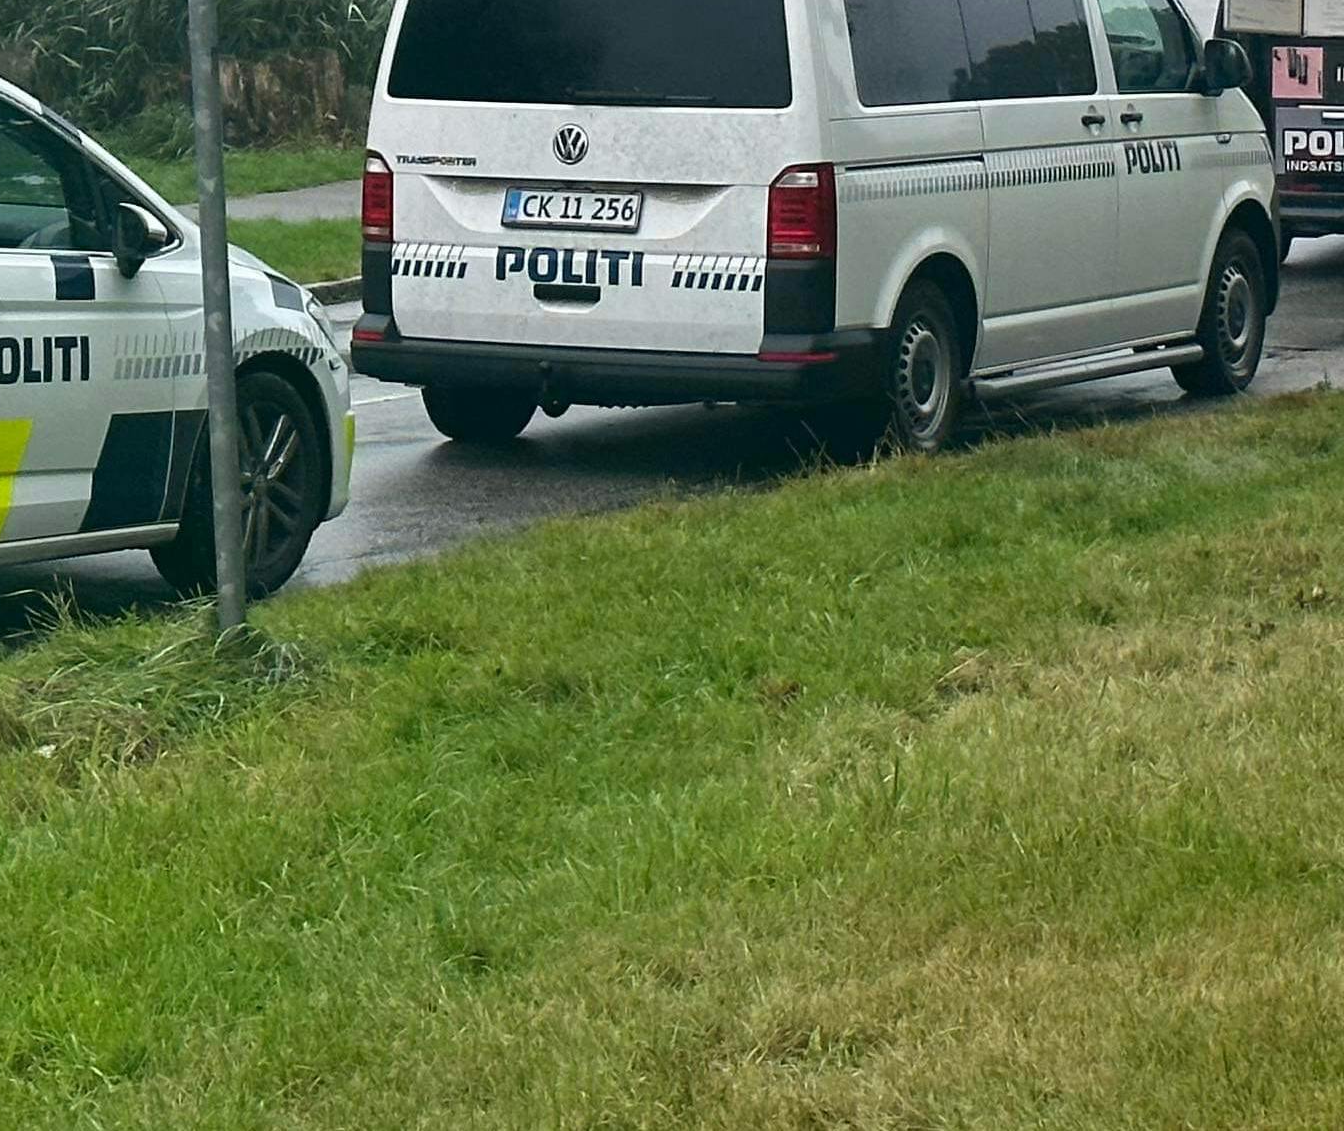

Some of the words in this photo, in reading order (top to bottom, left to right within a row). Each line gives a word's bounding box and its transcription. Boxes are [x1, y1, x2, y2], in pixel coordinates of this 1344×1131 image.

[1124, 140, 1181, 175] POLITI
[523, 195, 556, 219] CK
[560, 196, 582, 220] 11
[591, 198, 635, 223] 256
[496, 246, 645, 287] POLITI
